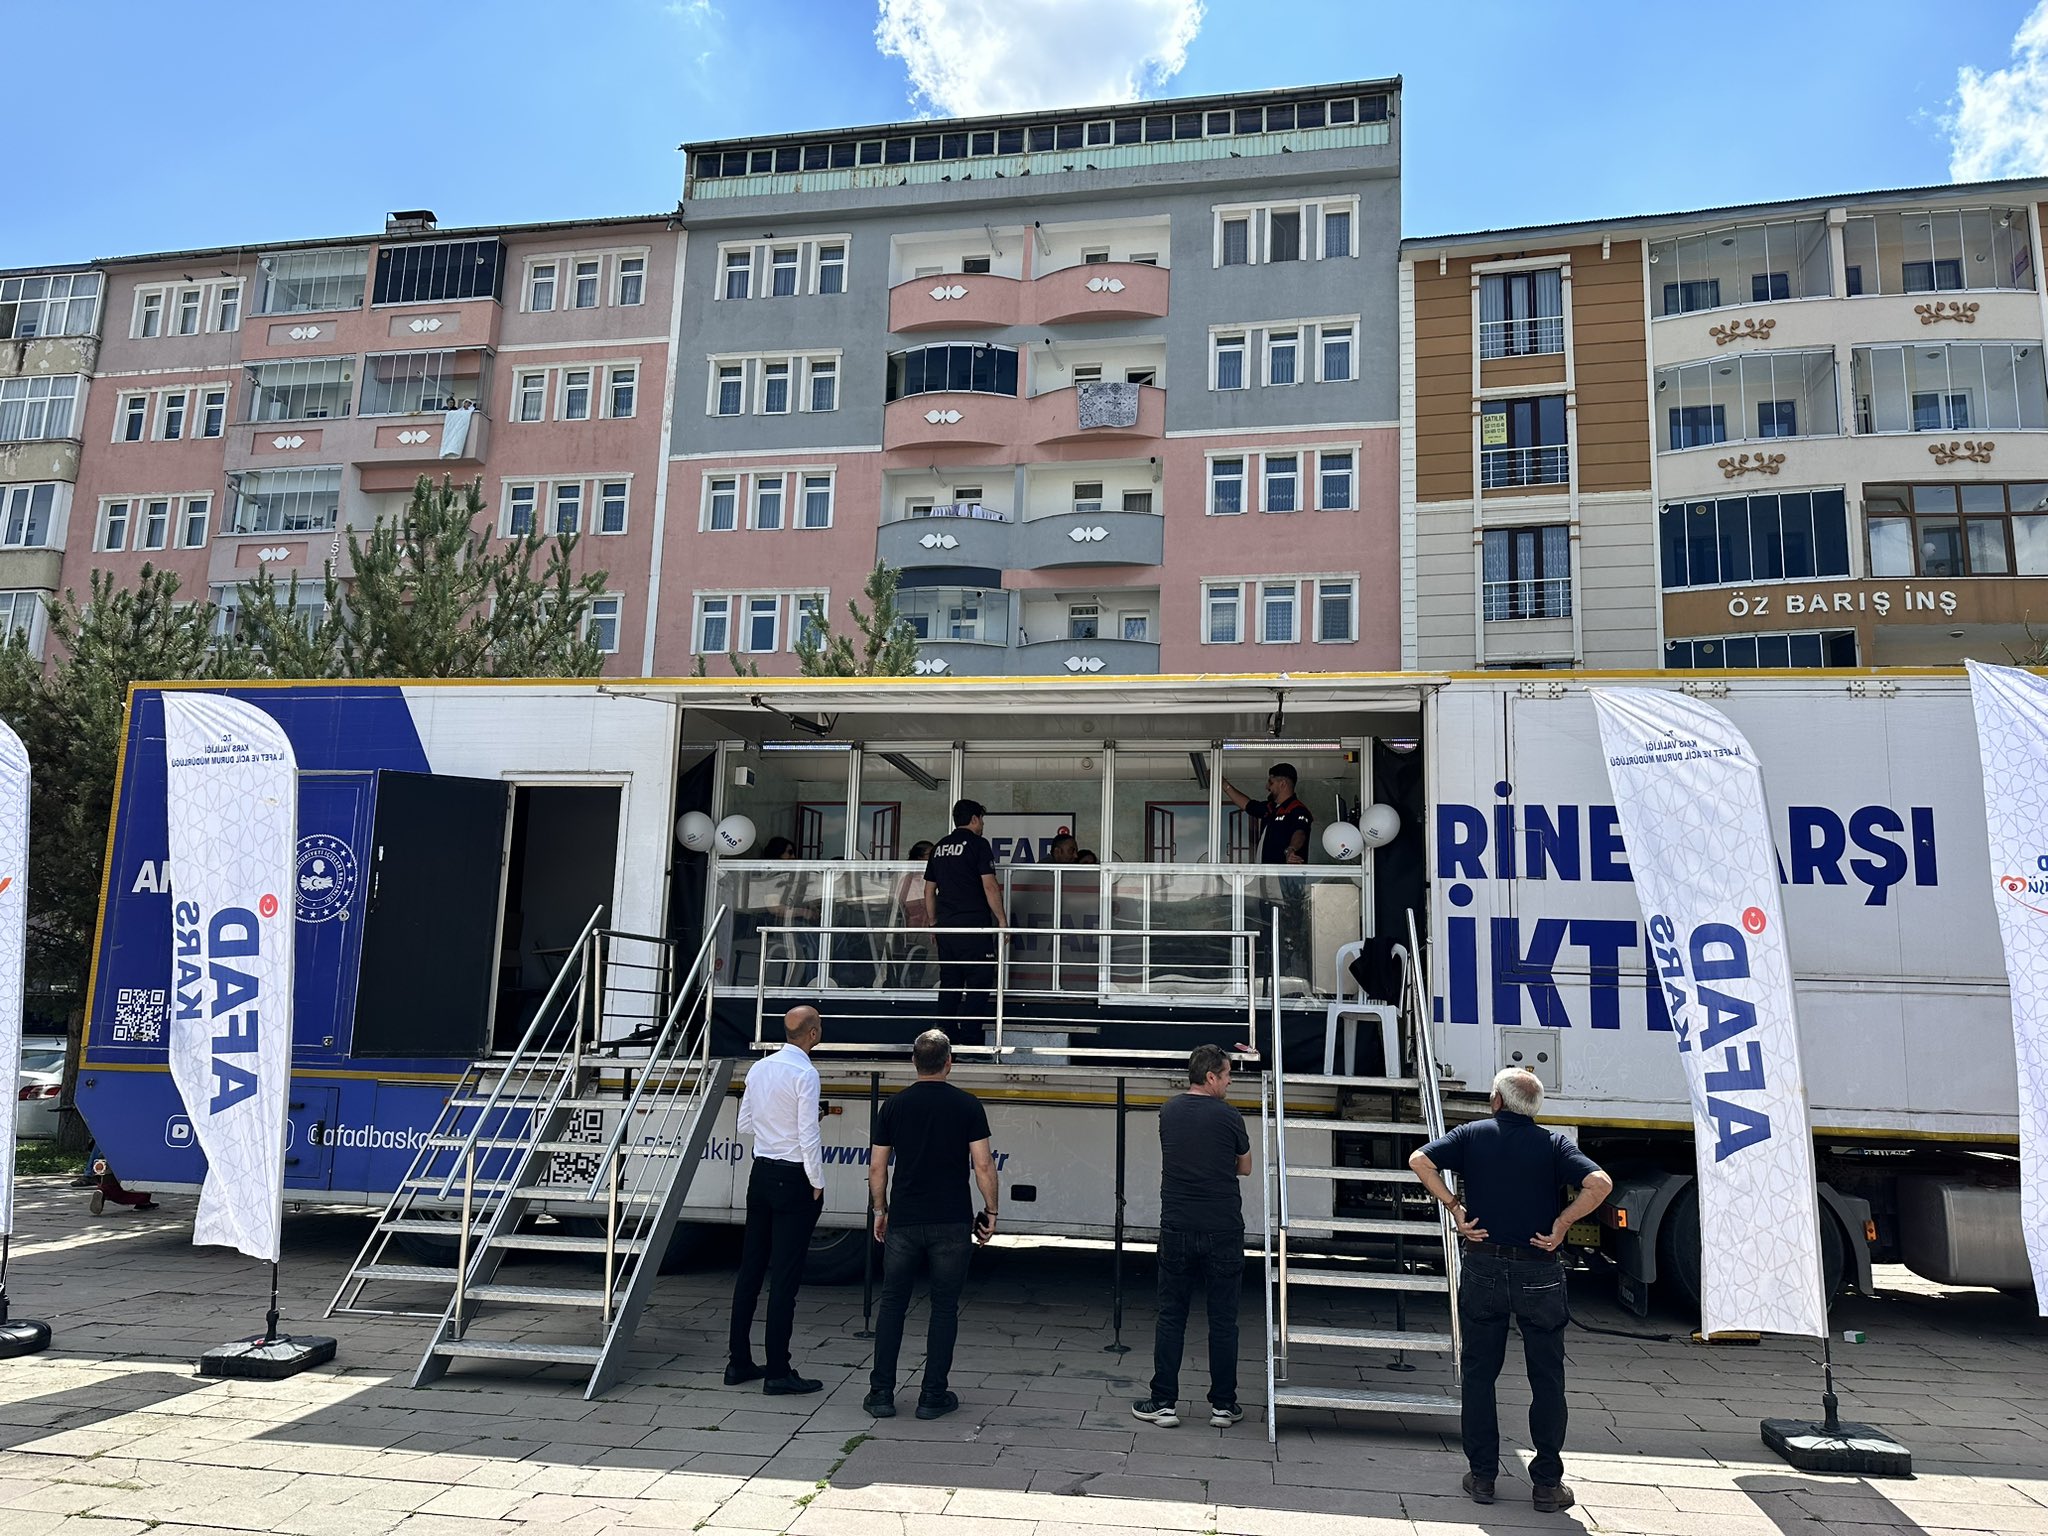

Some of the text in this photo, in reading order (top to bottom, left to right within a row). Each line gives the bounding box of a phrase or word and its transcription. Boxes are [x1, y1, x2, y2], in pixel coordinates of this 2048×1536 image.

[1484, 414, 1505, 423] SATILIK
[1728, 585, 1957, 617] ÖZ BARIŞ İNŞ
[720, 831, 738, 847] AFAD
[934, 843, 963, 859] AFAD
[1775, 805, 1939, 906] RŞI
